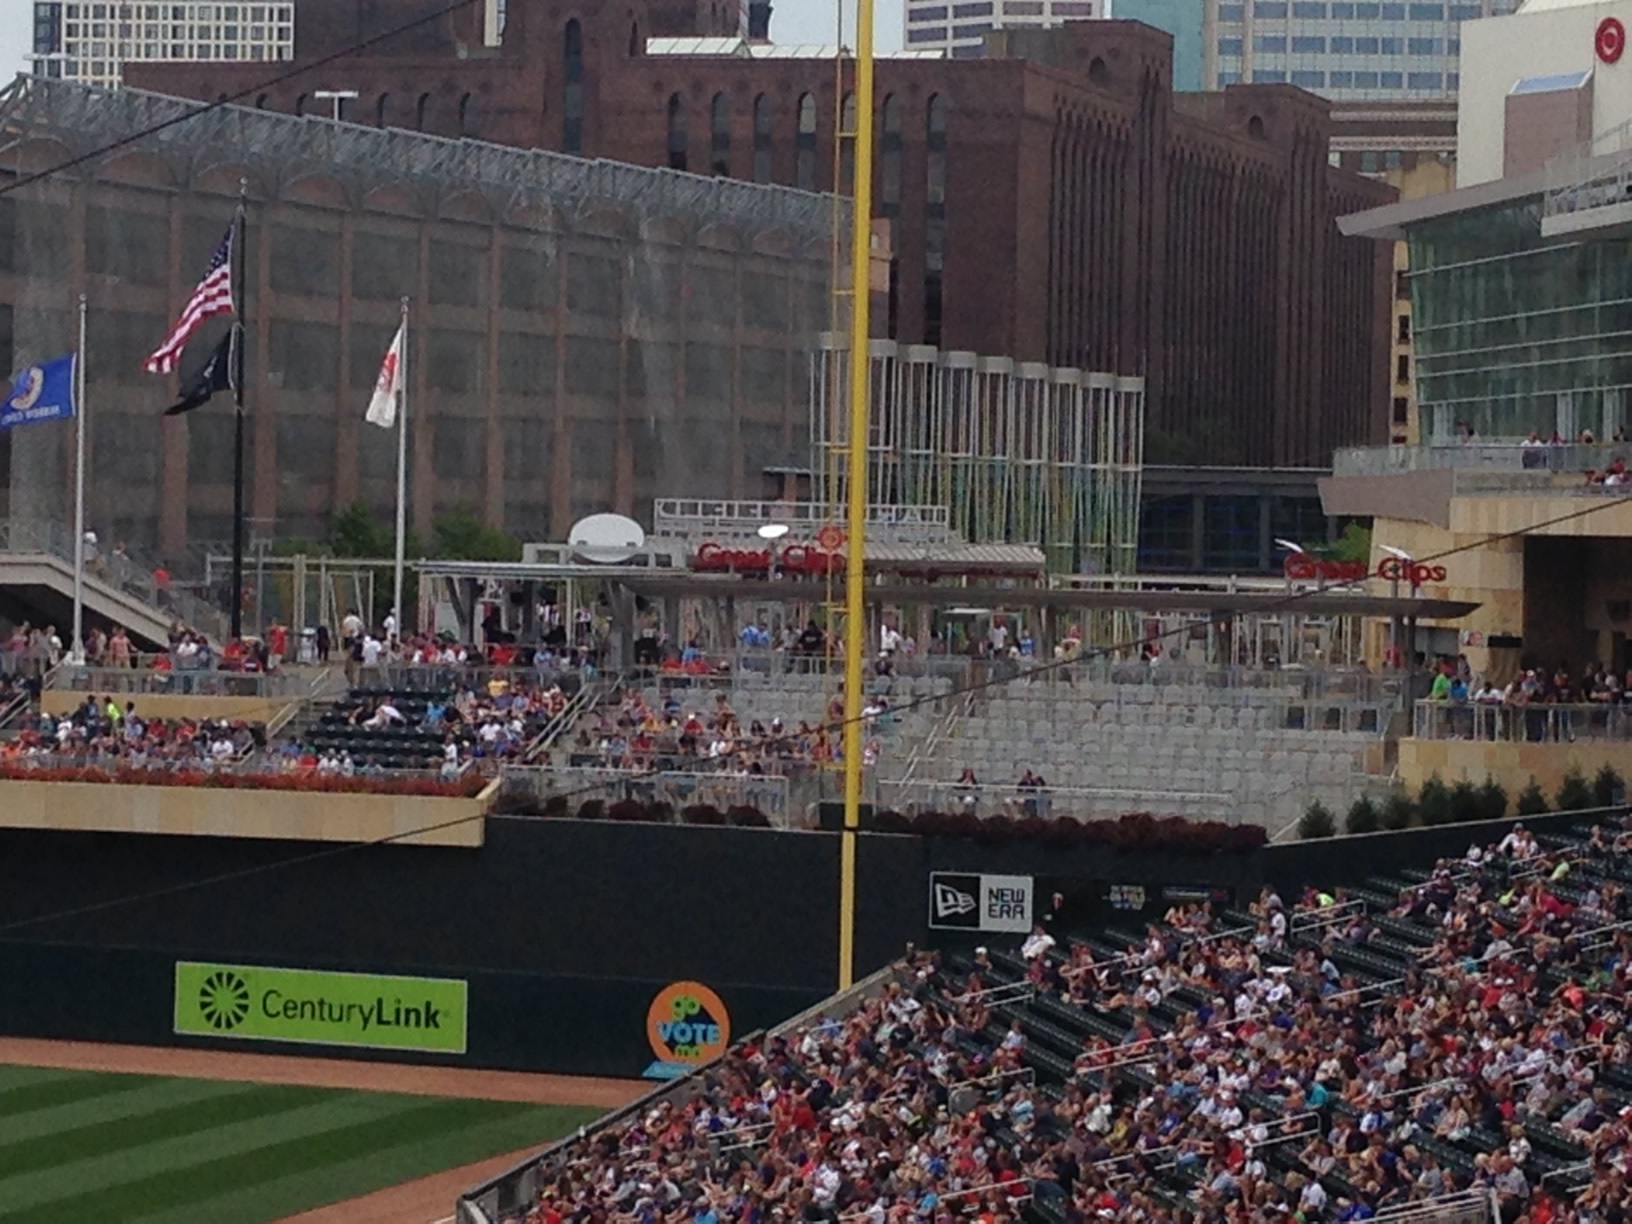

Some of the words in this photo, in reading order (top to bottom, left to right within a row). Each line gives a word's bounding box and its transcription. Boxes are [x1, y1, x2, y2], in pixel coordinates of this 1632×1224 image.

[1379, 557, 1447, 587] Clips
[988, 887, 1025, 903] NEW
[988, 904, 1025, 919] ERA
[262, 989, 441, 1031] CenturyLink
[671, 995, 700, 1021] go
[656, 1021, 720, 1046] VOTE
